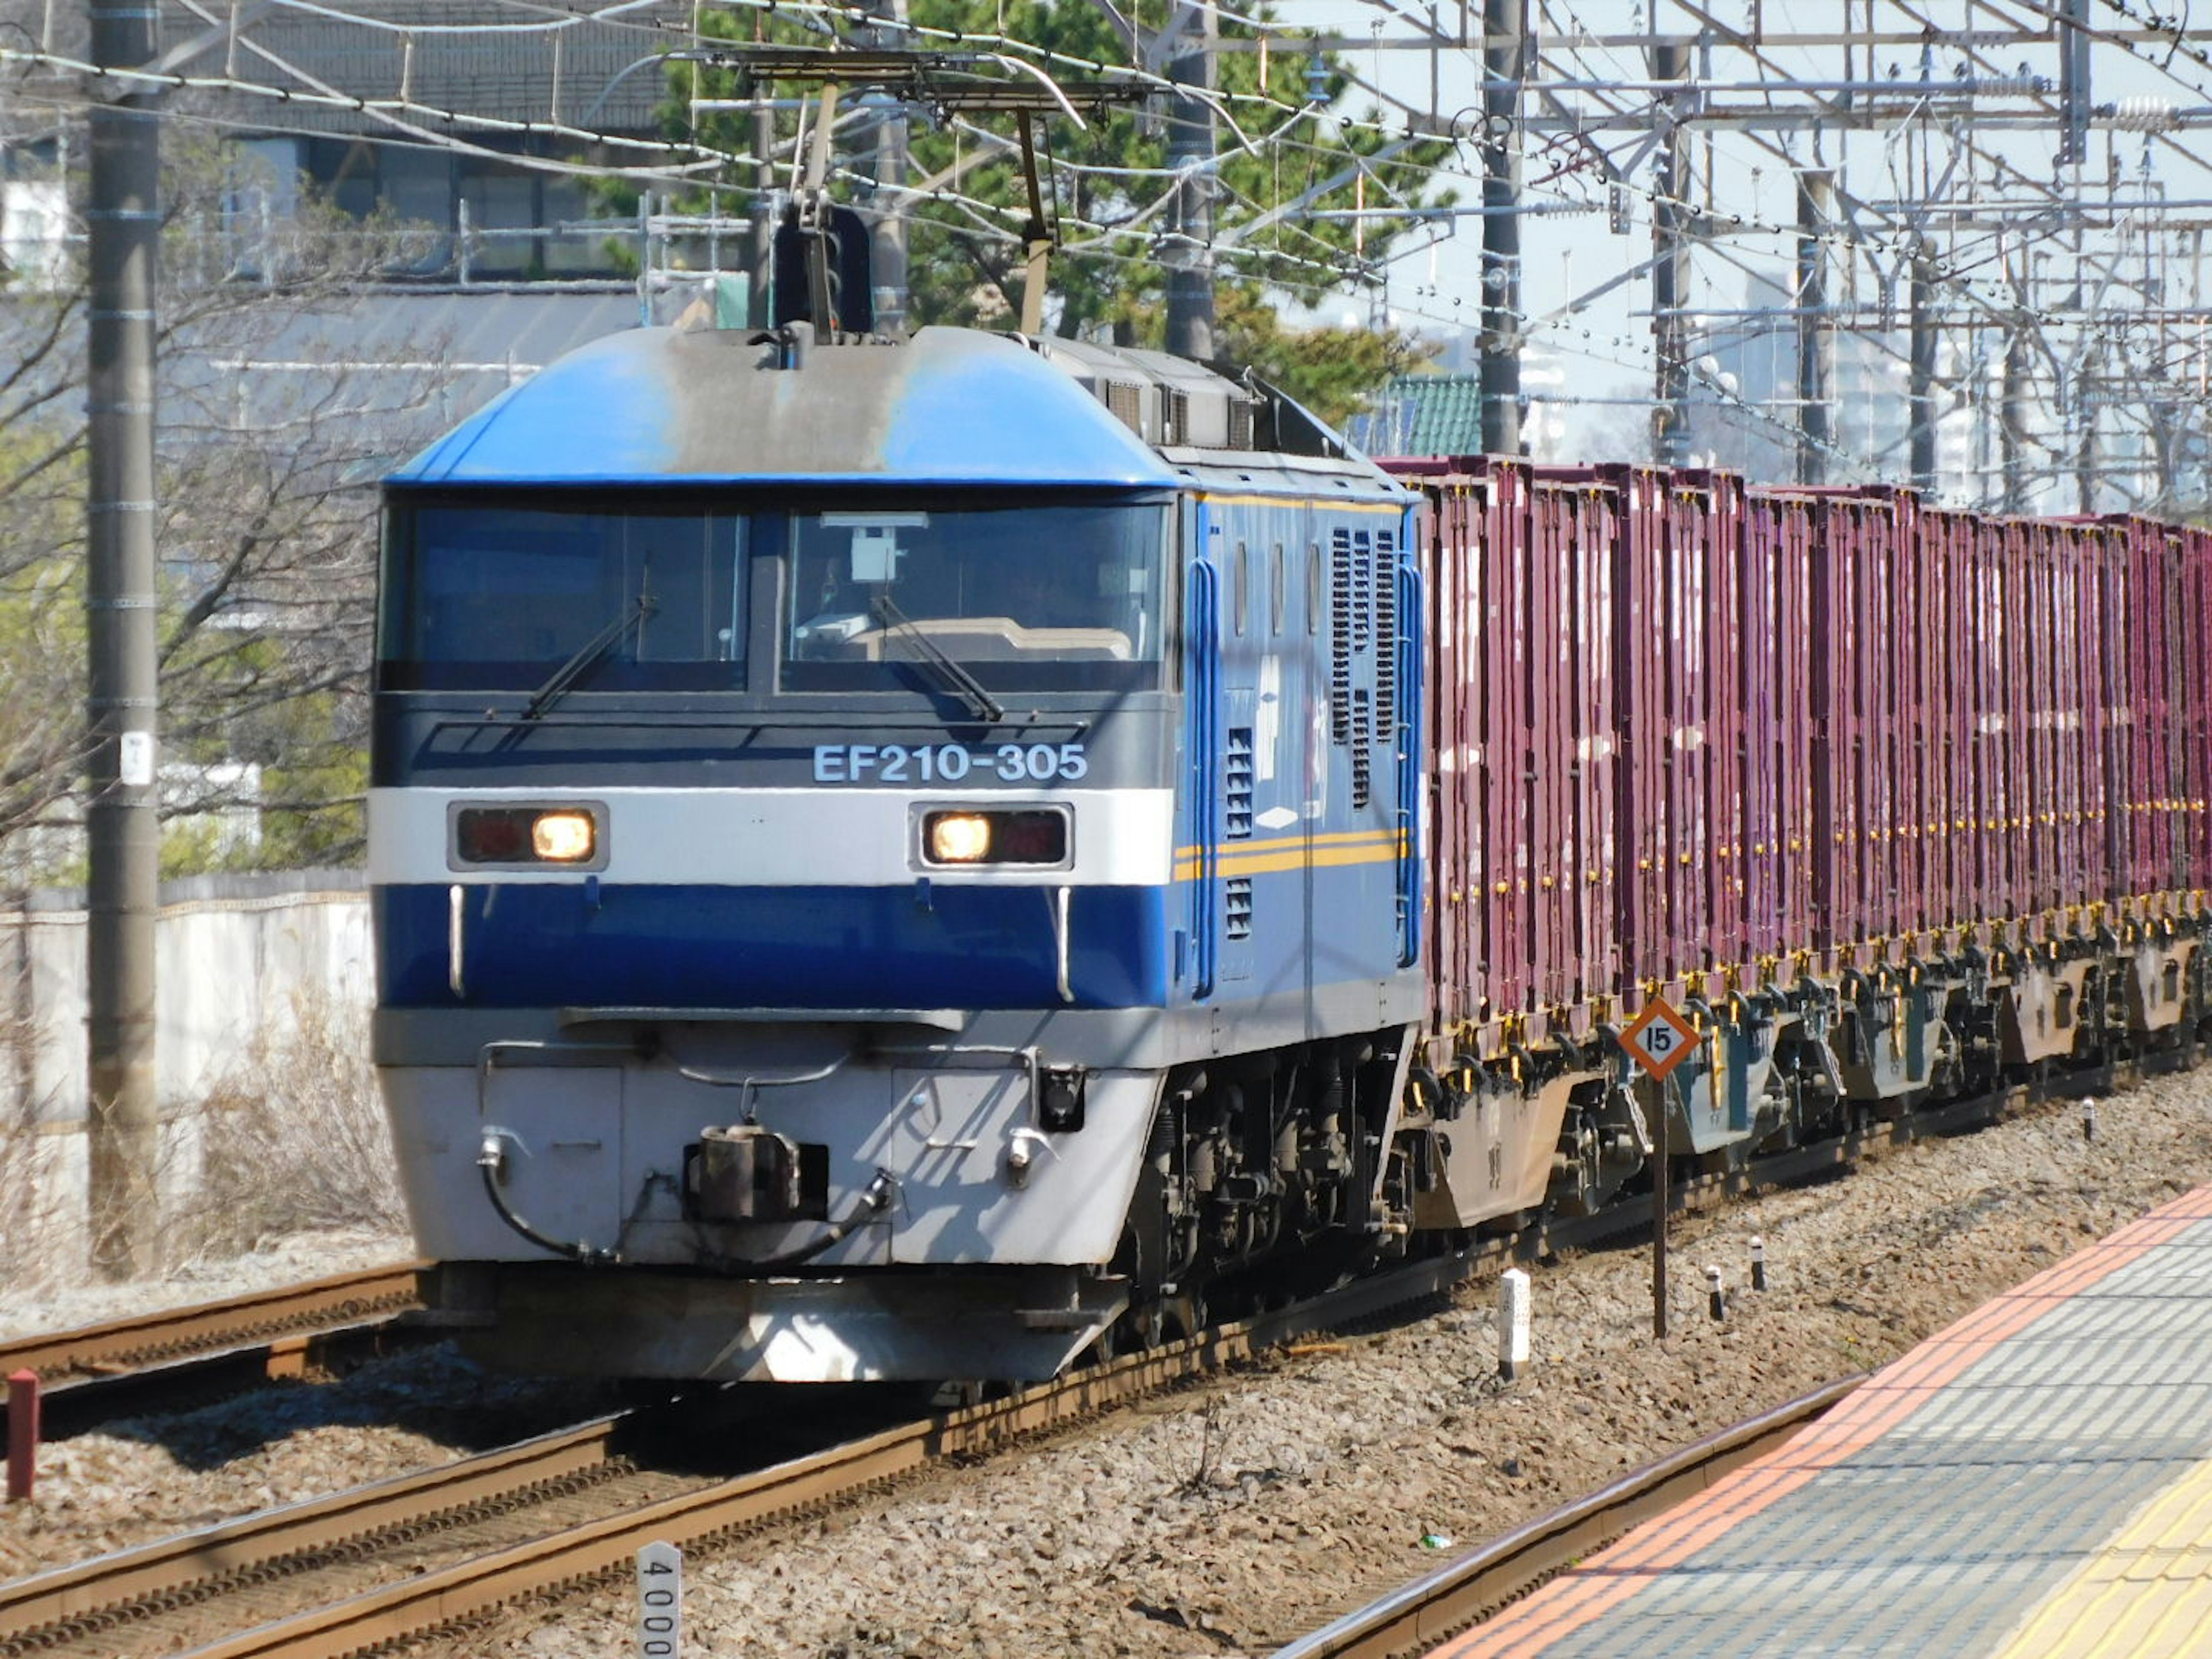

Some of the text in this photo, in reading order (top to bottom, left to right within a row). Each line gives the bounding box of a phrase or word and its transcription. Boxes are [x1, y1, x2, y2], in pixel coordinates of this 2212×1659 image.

[814, 744, 1088, 781] EF210-305
[1646, 1027, 1671, 1051] 15
[643, 1562, 673, 1655] 4000
